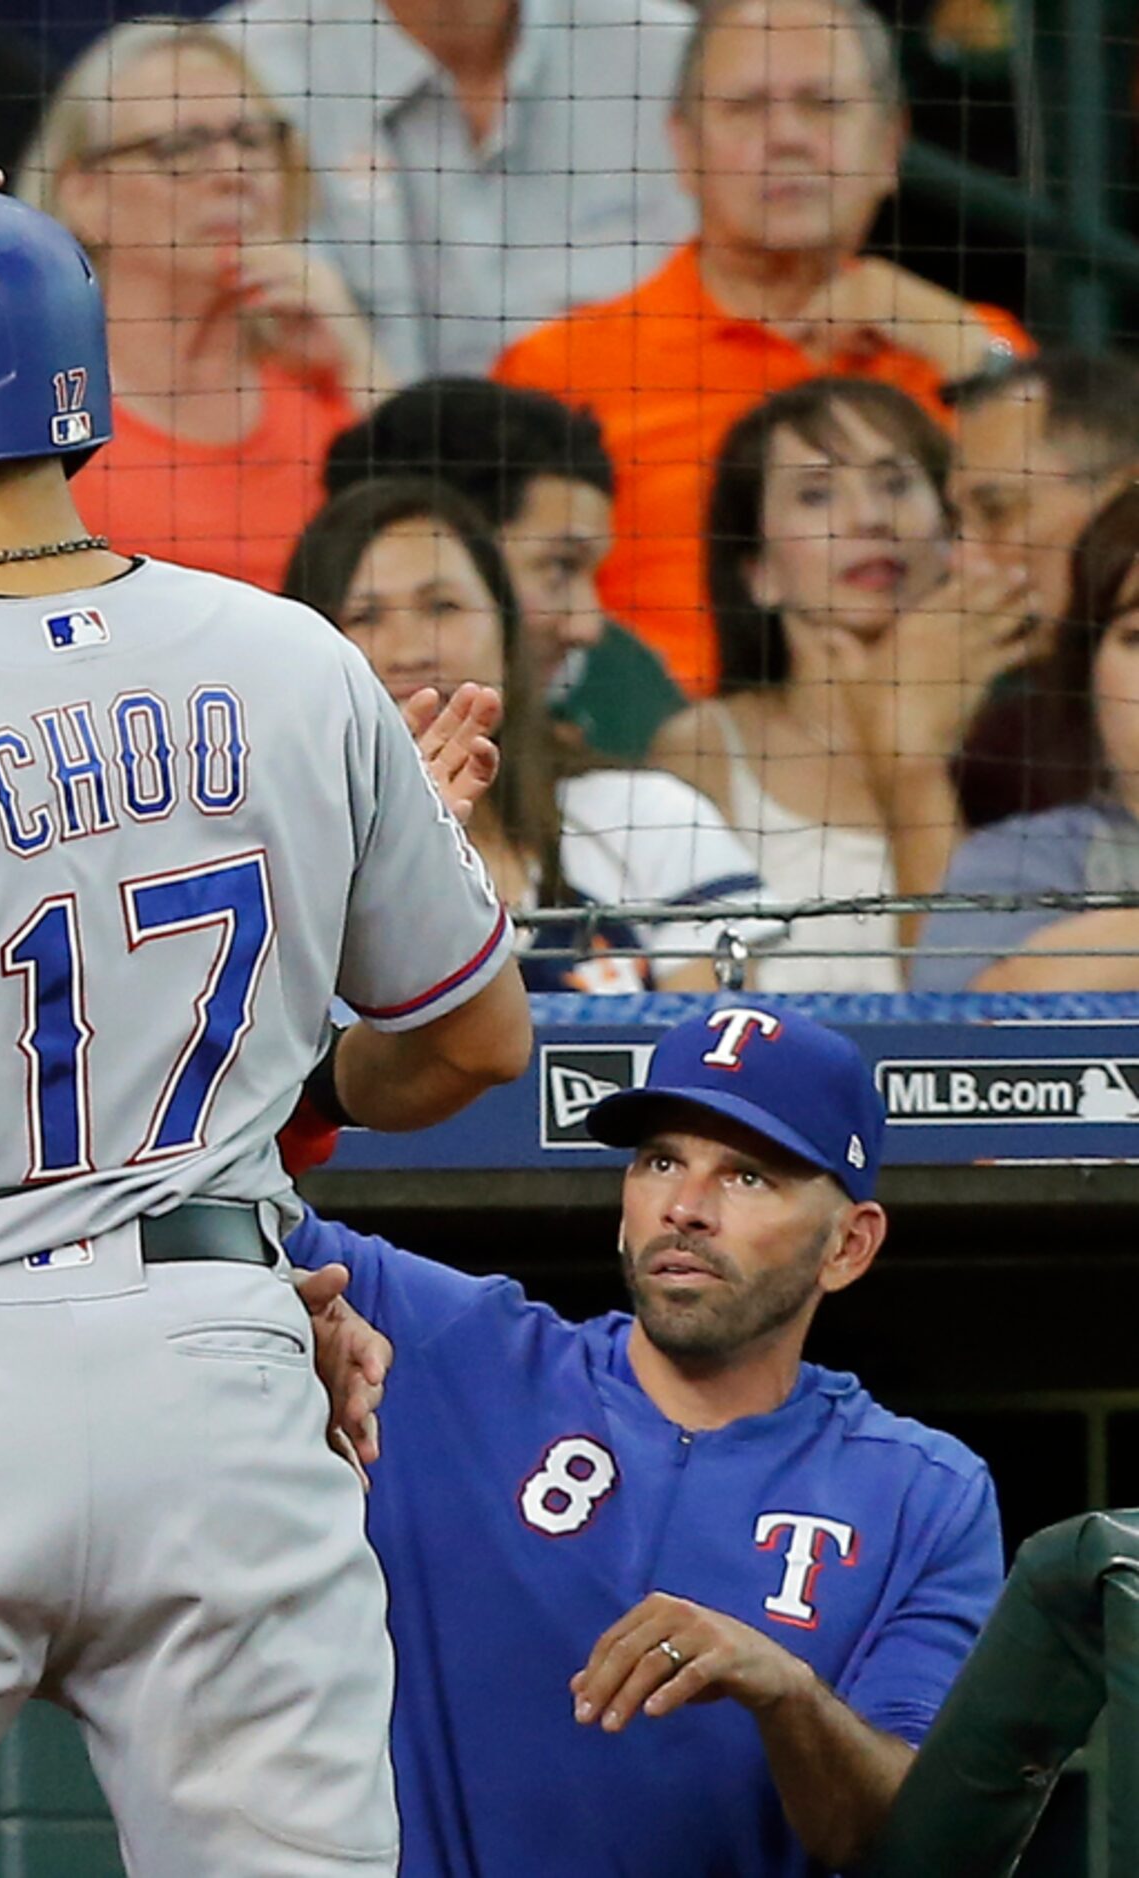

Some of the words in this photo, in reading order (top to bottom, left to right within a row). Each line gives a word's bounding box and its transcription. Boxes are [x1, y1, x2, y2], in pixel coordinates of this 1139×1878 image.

[52, 367, 88, 413] 17
[0, 848, 276, 1184] 17
[703, 1006, 784, 1072] T
[887, 1071, 1074, 1114] MLB.com
[516, 1434, 621, 1538] 8
[753, 1511, 858, 1630] T
